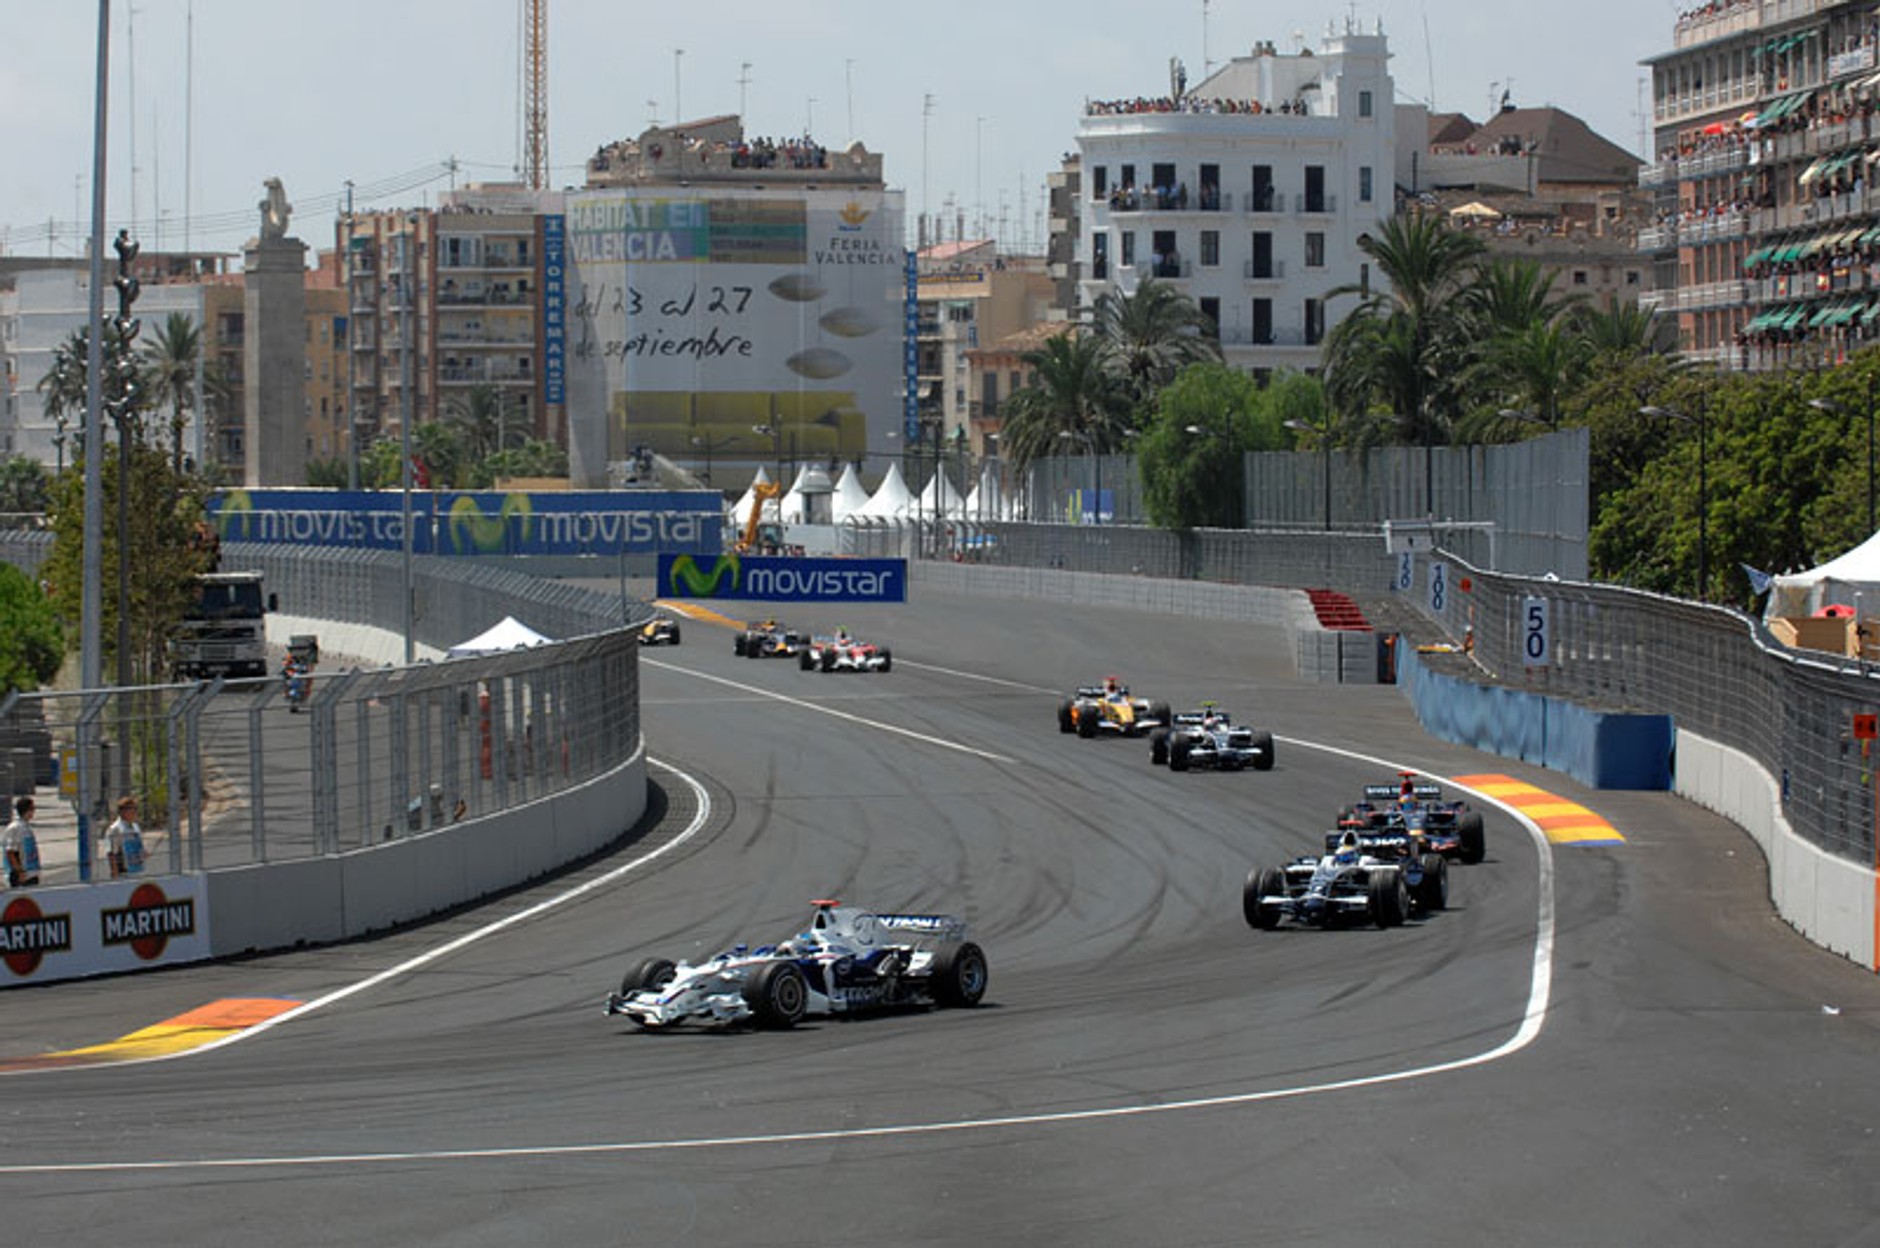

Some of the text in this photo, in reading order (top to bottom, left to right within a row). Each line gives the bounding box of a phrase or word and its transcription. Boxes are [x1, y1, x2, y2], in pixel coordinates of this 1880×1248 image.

[571, 200, 655, 230] HABITAT
[570, 231, 678, 264] VALENCIA
[815, 251, 897, 266] VALENCIA
[830, 237, 880, 251] FERIA
[575, 283, 752, 321] del 23 al 27
[603, 327, 752, 363] septiembre
[260, 510, 423, 540] movistar
[540, 511, 711, 543] movistar
[748, 569, 892, 595] movistar
[1433, 564, 1444, 610] 100
[1527, 606, 1543, 658] 50
[106, 906, 190, 939] MARTINI
